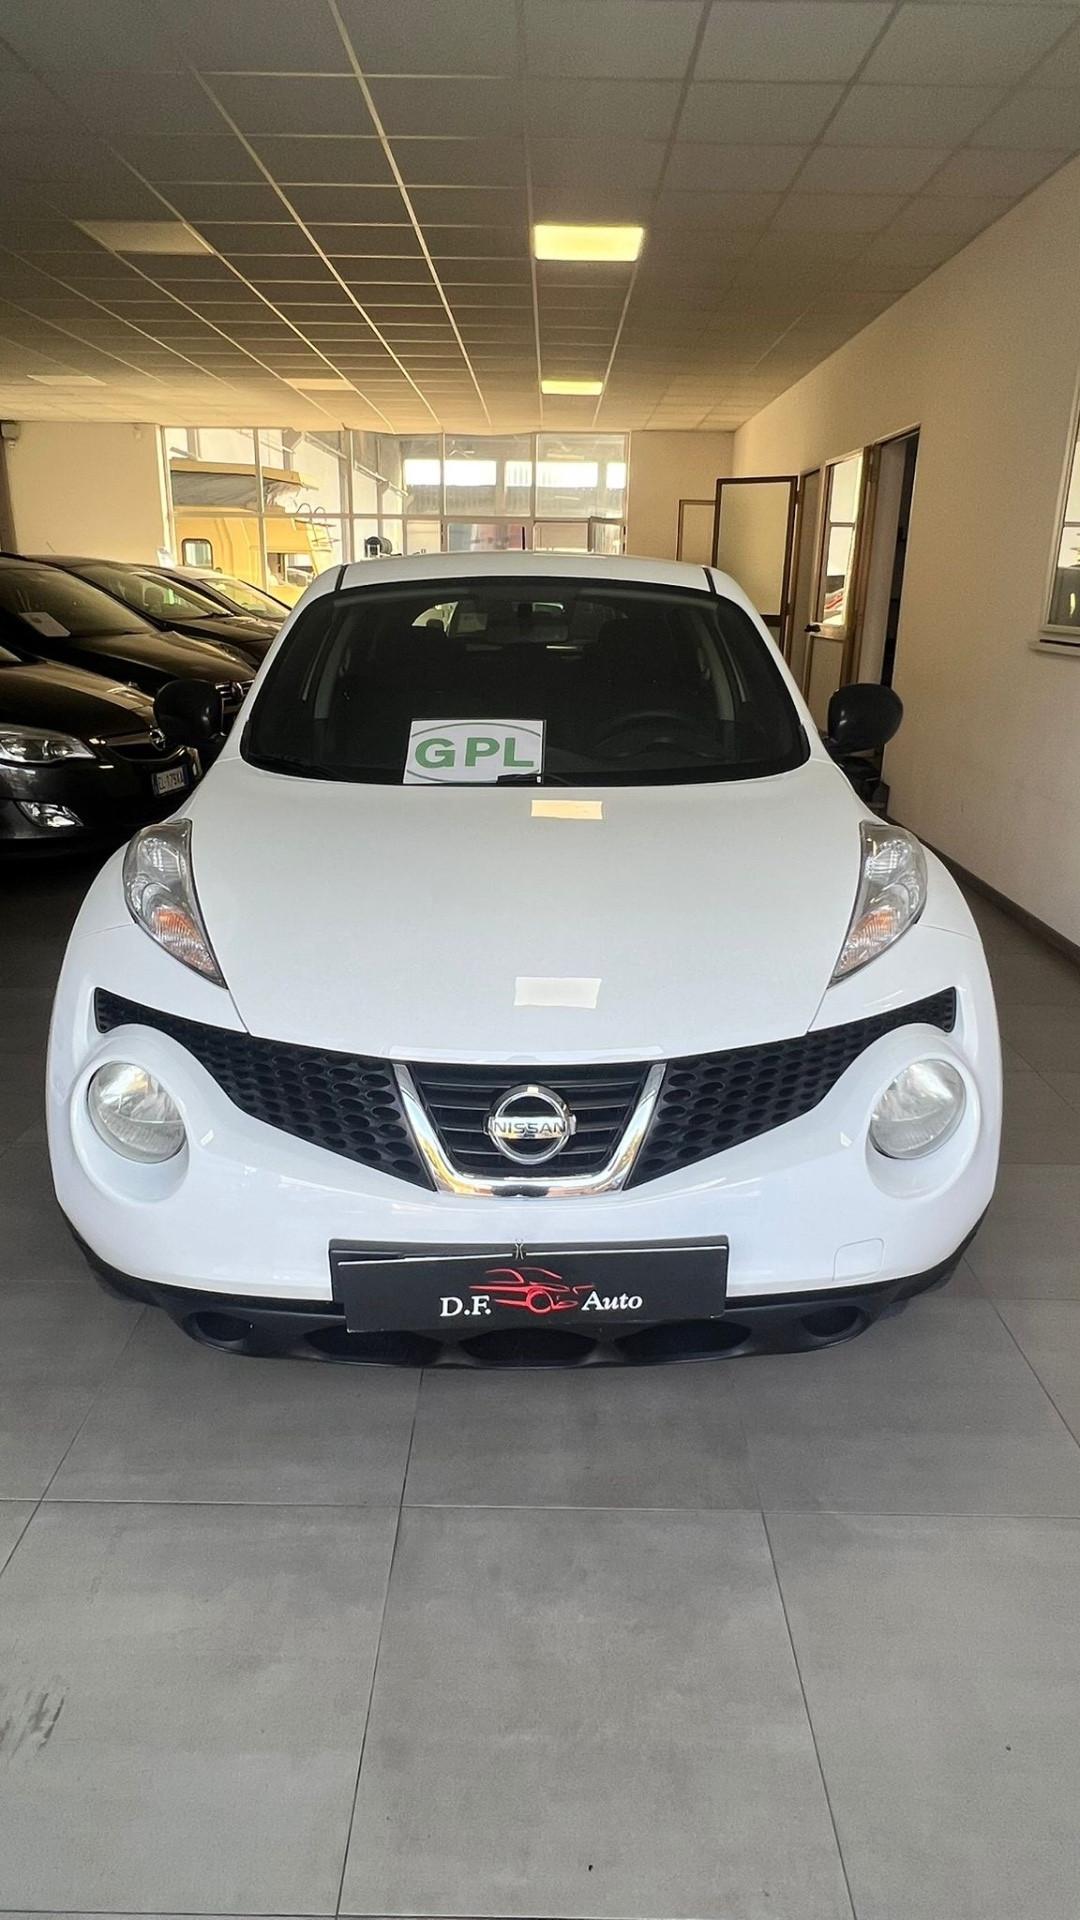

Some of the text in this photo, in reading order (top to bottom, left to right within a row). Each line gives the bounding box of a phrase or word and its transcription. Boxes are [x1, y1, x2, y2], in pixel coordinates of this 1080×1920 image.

[415, 737, 534, 768] GPL
[494, 1122, 566, 1134] NISSAN
[440, 1290, 643, 1317] D.F. Auto
